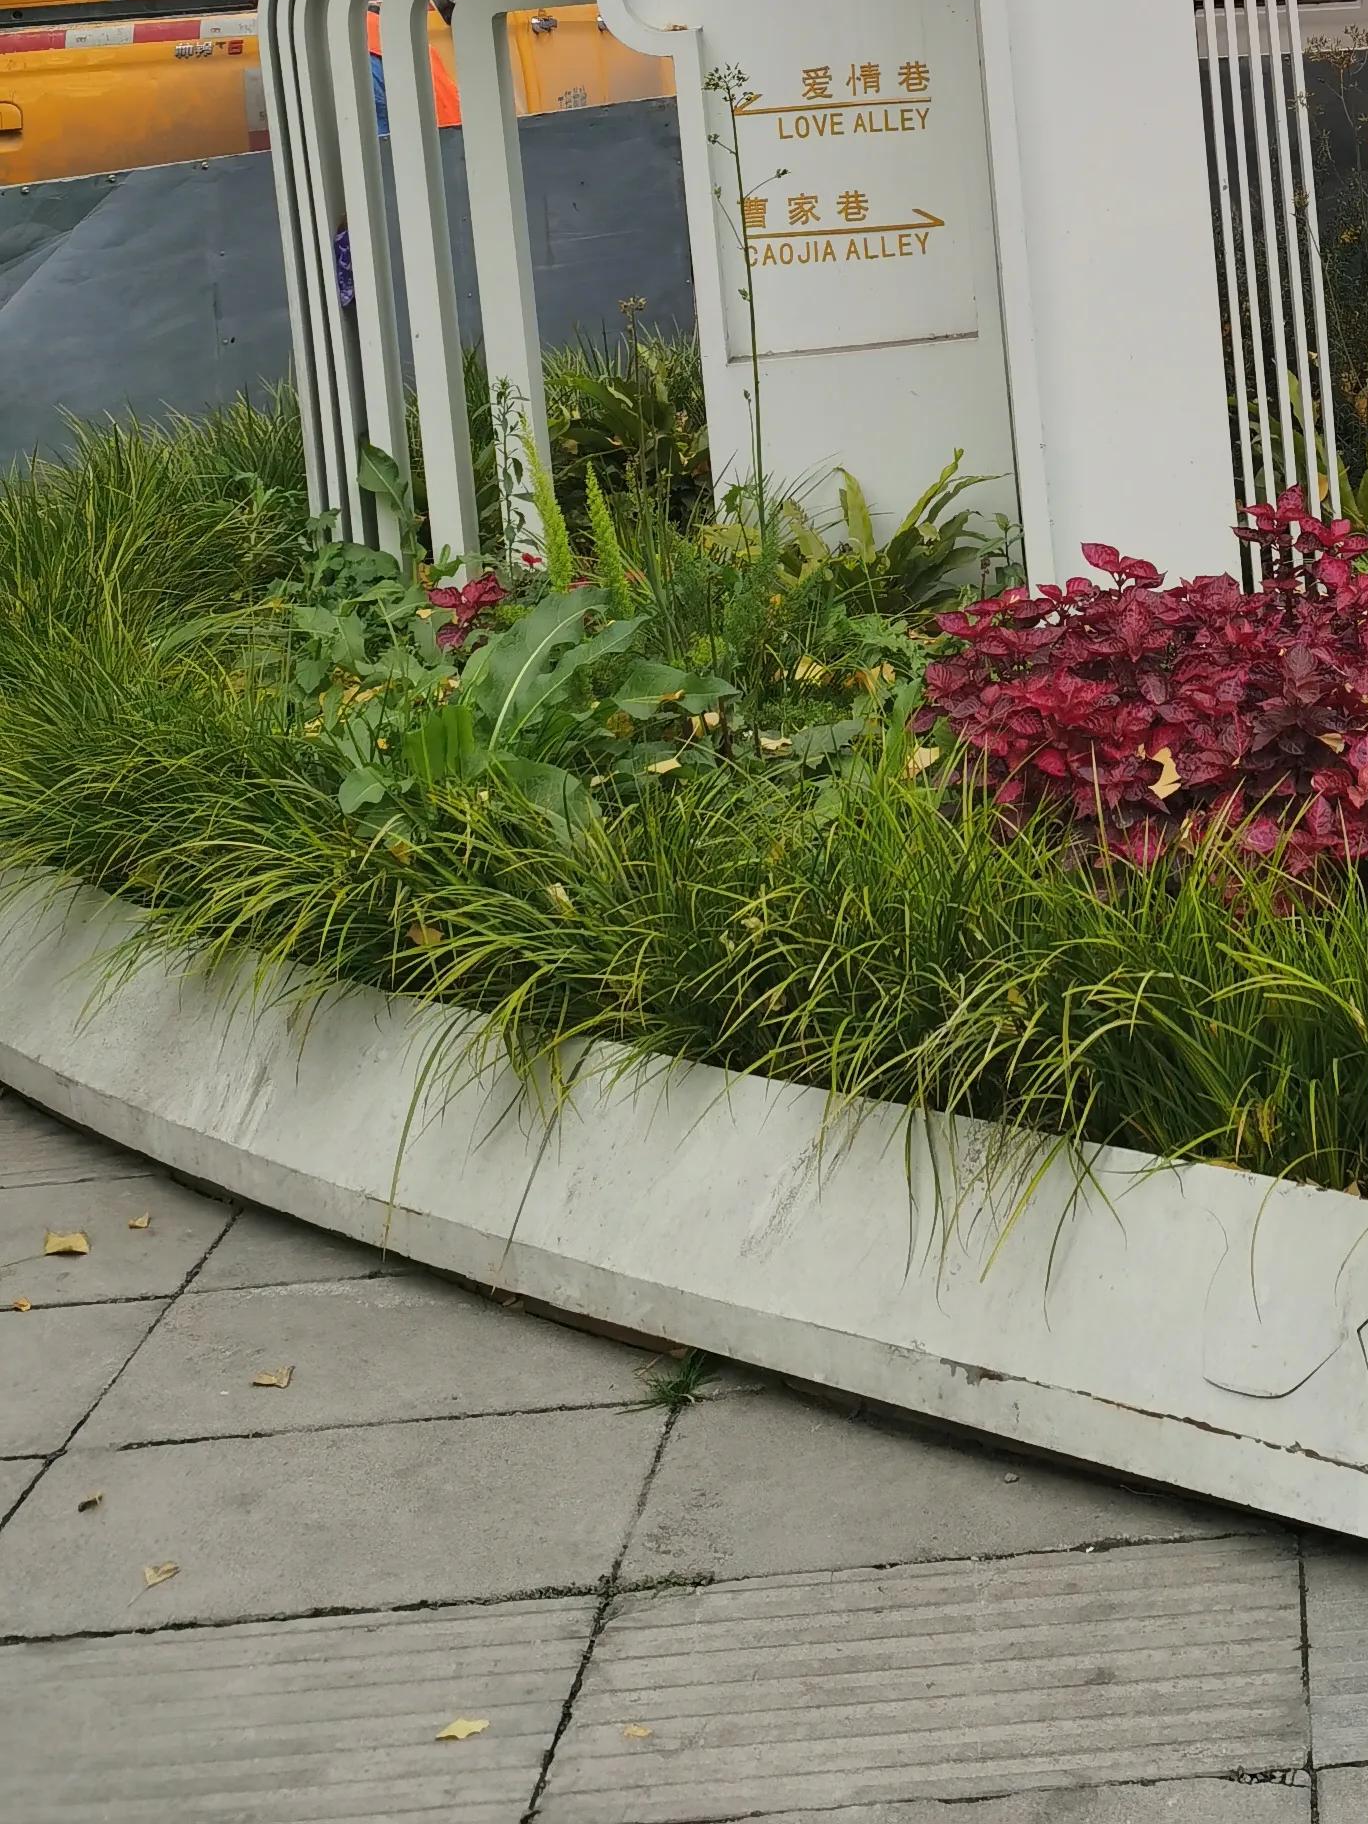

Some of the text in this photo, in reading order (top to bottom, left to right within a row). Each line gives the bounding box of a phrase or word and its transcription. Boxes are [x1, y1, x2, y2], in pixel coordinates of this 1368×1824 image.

[802, 60, 930, 100] 爱情巷
[777, 107, 931, 140] LOVE ALLEY
[743, 189, 870, 228] 曹家巷
[747, 231, 930, 268] CAOJIA ALLEY
